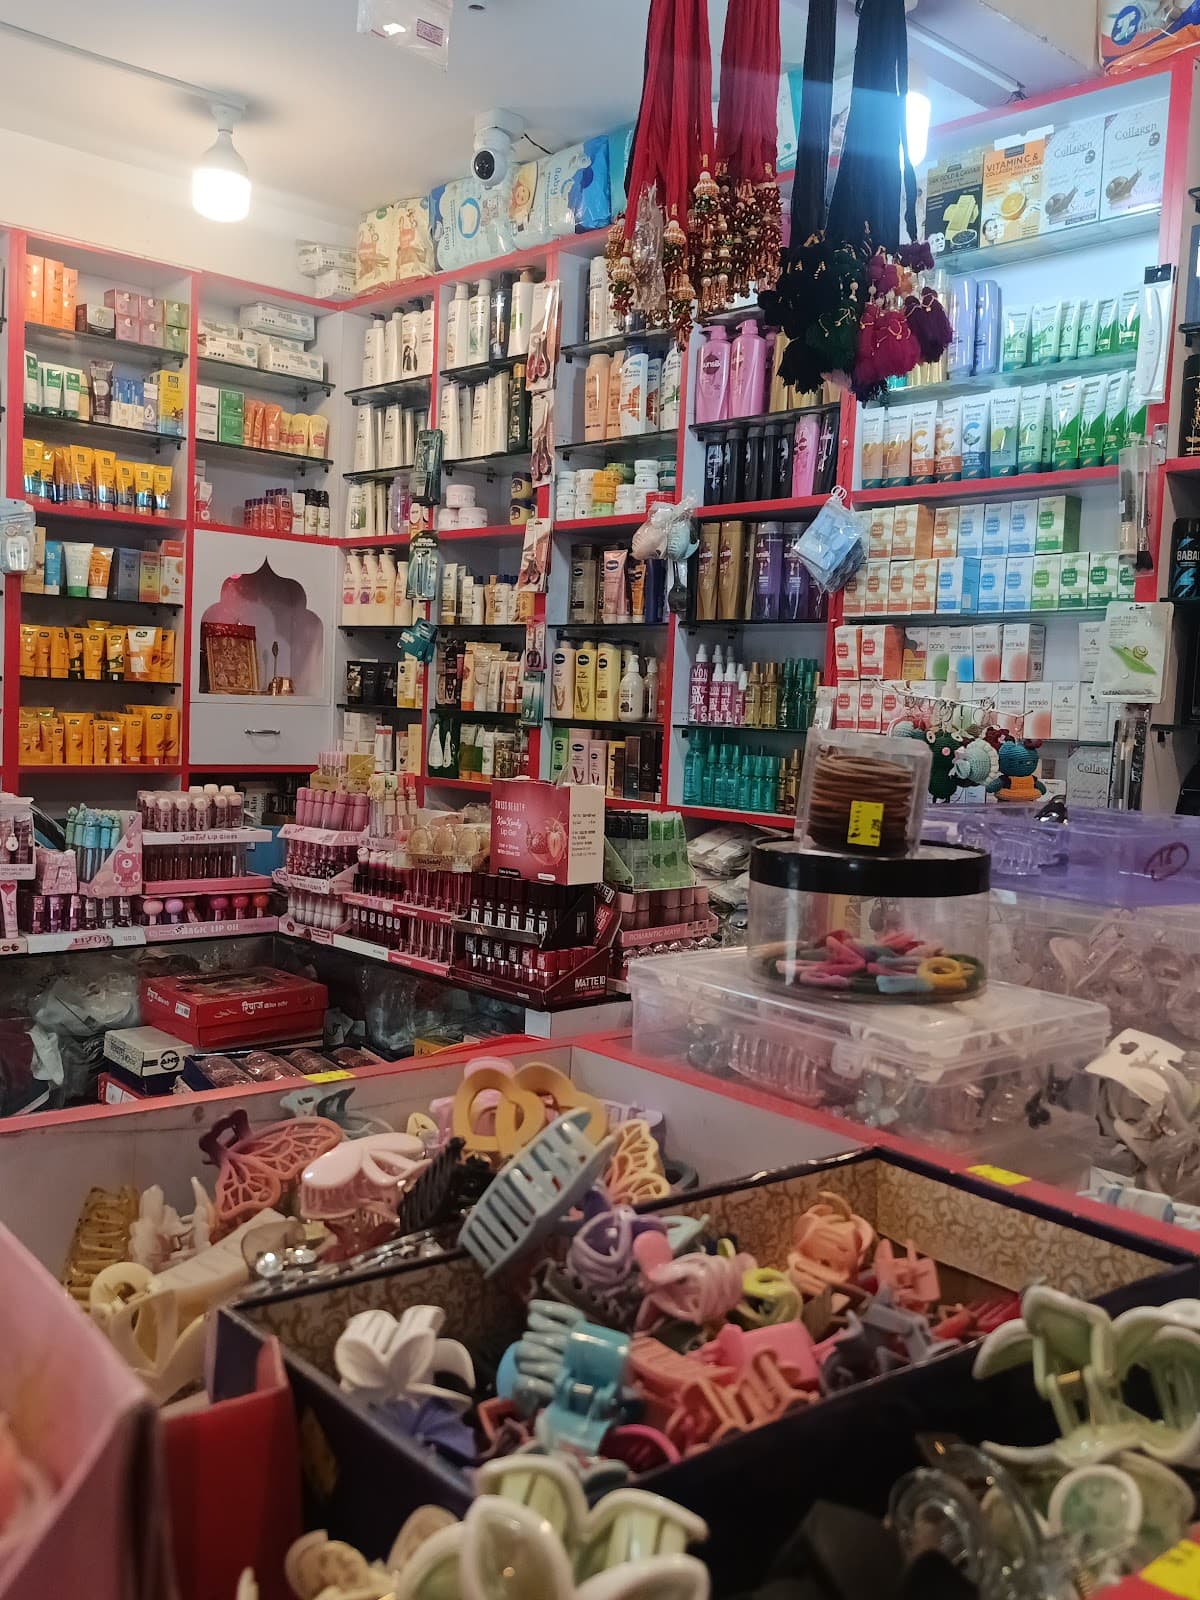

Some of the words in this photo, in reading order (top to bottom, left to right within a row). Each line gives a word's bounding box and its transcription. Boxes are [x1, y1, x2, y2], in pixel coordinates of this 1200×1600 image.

[1115, 123, 1157, 141] Collagen
[1054, 141, 1093, 158] Collagen
[986, 156, 1023, 172] VITAMIN
[1023, 156, 1031, 165] C
[1032, 153, 1039, 161] &
[928, 642, 945, 650] acne
[1077, 763, 1109, 777] Collage
[210, 924, 225, 933] LIP
[226, 923, 240, 932] OIL
[574, 977, 600, 989] MATTE
